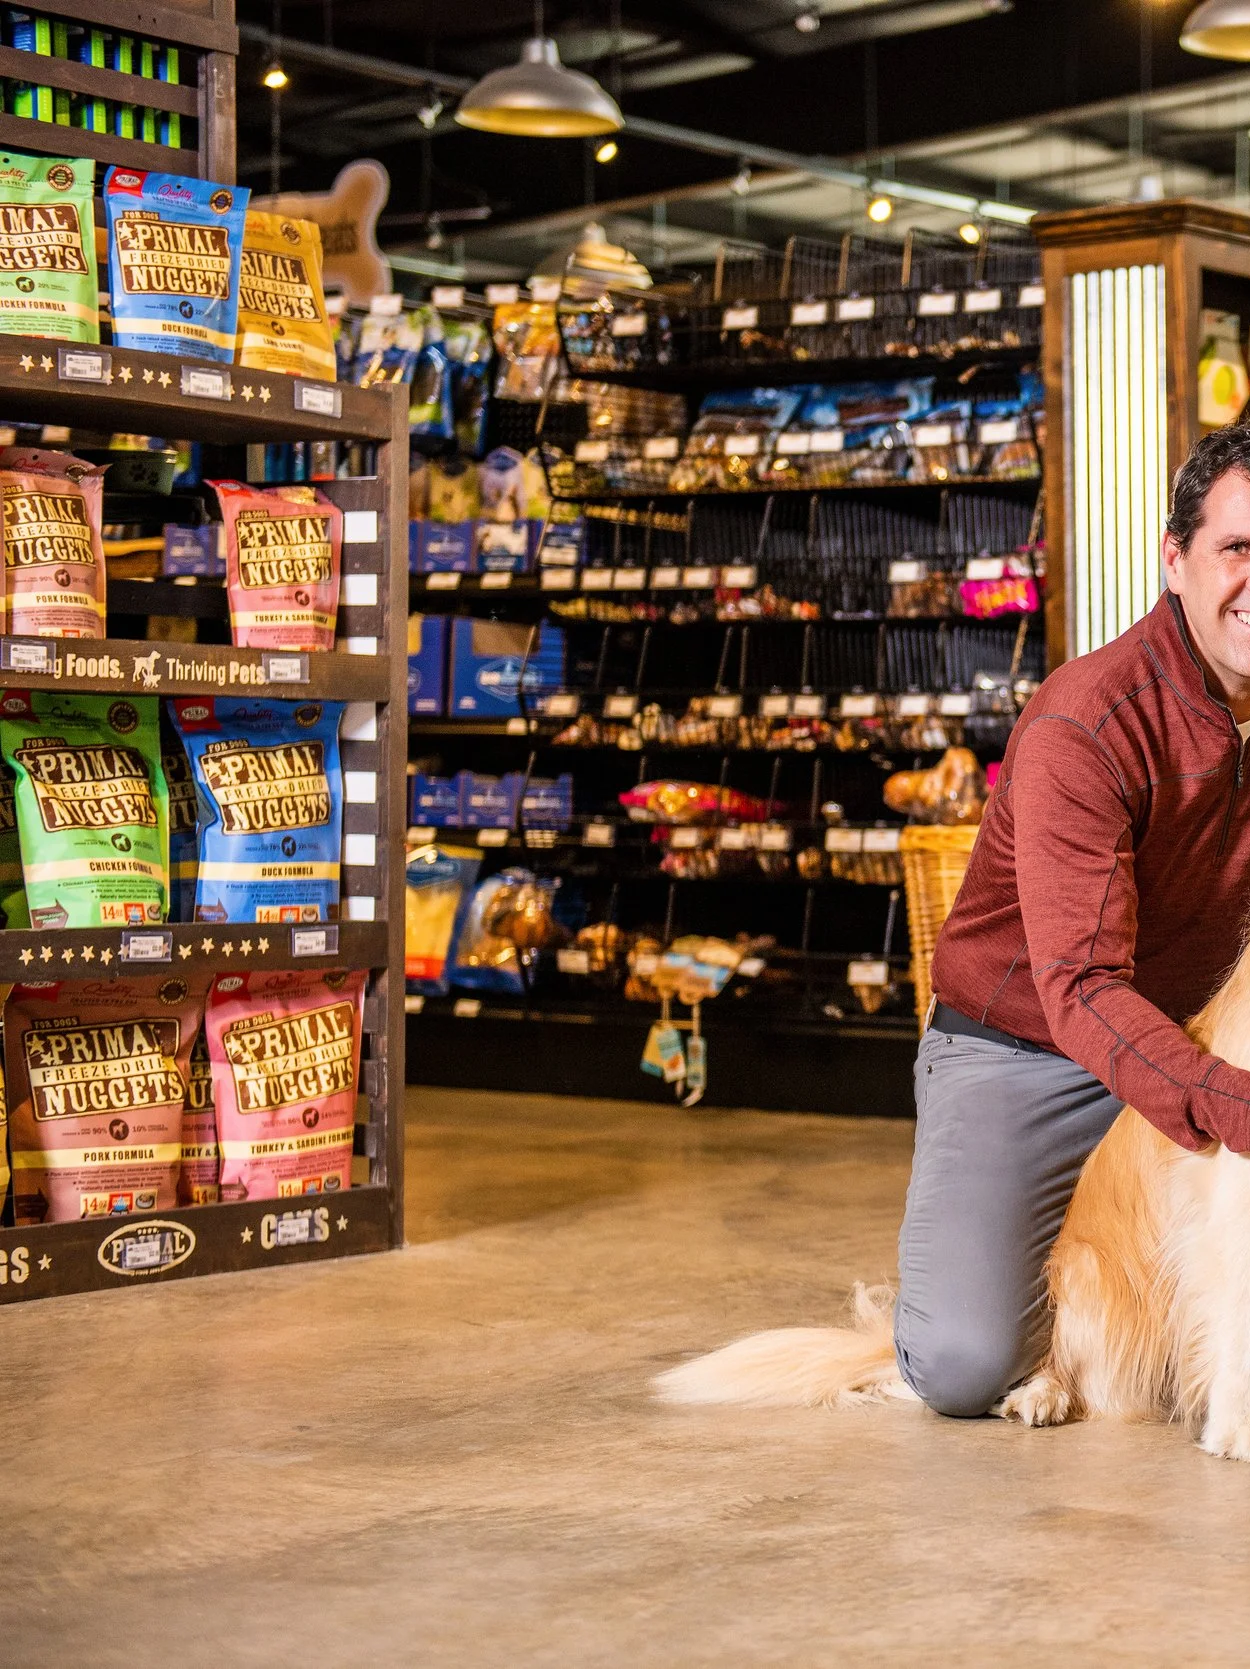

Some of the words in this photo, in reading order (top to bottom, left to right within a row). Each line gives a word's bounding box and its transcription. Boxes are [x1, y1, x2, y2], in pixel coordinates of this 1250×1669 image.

[134, 224, 221, 255] PRIMAL
[130, 266, 229, 296] NUGGETS
[29, 301, 67, 312] FORMULA
[162, 323, 181, 333] DUCK
[250, 519, 329, 547] PRIMAL
[36, 595, 58, 604] PORK
[60, 594, 89, 606] FORMULA
[66, 653, 125, 679] Foods.
[166, 657, 227, 687] Thriving
[26, 738, 44, 749] FOR
[209, 742, 228, 753] FOR
[36, 750, 143, 784] PRIMAL
[221, 746, 318, 786] PRIMAL
[49, 795, 157, 826] NUGGETS
[228, 794, 327, 830] NUGGETS
[89, 861, 127, 872] CHICKEN
[261, 868, 283, 877] DUCK
[284, 867, 314, 876] FORMULA
[34, 1020, 52, 1029] FOR
[54, 1016, 78, 1027] DOGS
[233, 1019, 250, 1031] FOR
[252, 1013, 273, 1027] DOGS
[241, 1010, 348, 1061] PRIMAL
[43, 1072, 183, 1116] NUGGETS
[246, 1057, 353, 1108] NUGGETS
[83, 1151, 110, 1163] PORK
[113, 1149, 154, 1162] FORMULA
[251, 1142, 285, 1154] TURKEY
[296, 1136, 327, 1149] SARDINE
